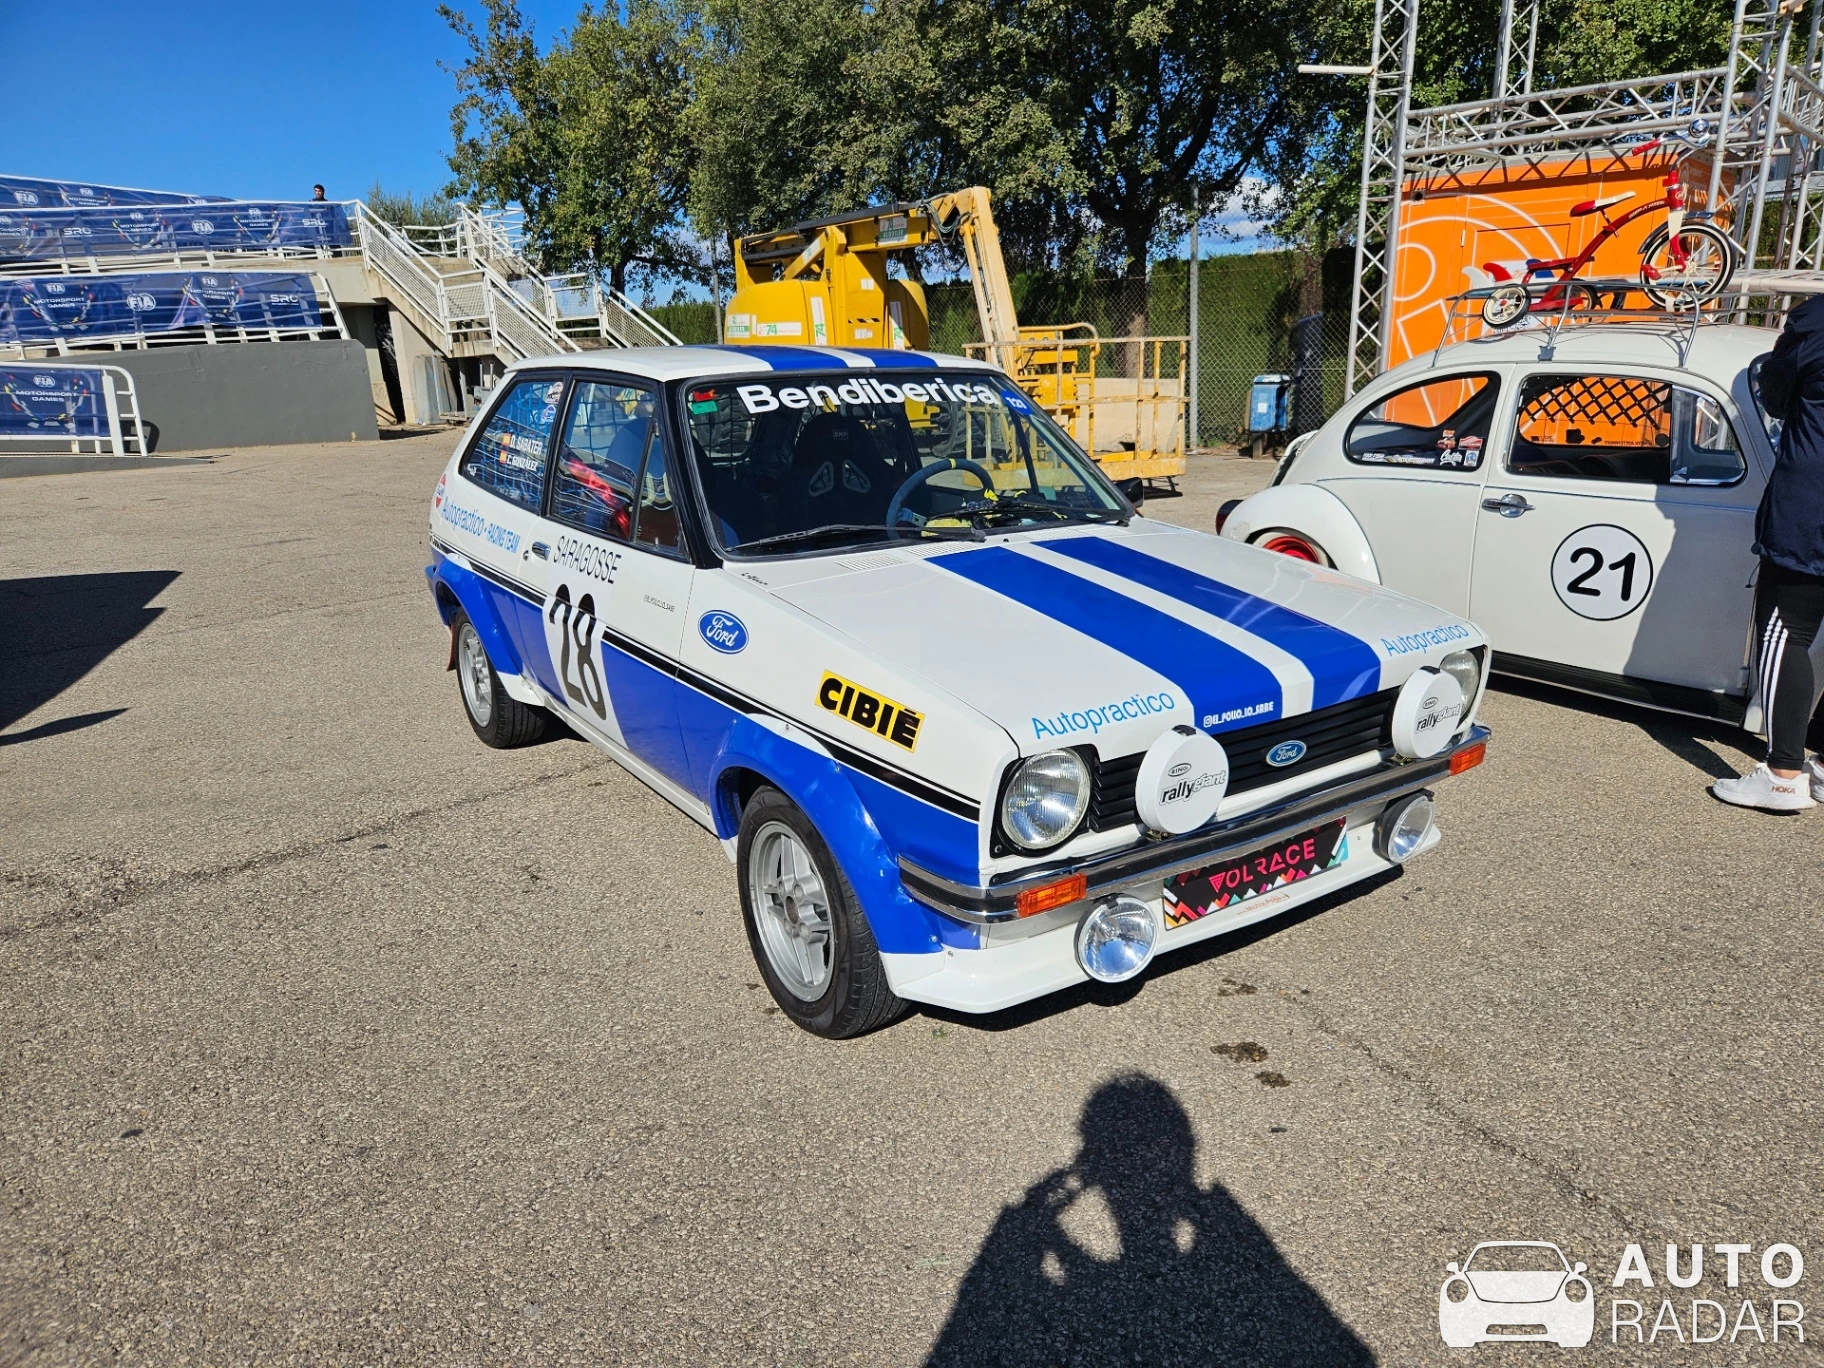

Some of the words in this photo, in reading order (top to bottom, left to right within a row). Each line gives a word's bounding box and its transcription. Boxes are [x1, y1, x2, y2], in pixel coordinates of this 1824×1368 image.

[193, 220, 214, 234] FIA
[46, 282, 66, 294] FIA
[128, 293, 156, 311] FIA
[33, 375, 55, 388] FIA
[736, 378, 999, 414] Bendiberica
[553, 535, 622, 585] SARAGOSSE
[1566, 547, 1636, 602] 21
[706, 615, 739, 647] Ford
[1380, 624, 1469, 656] Autopractico
[549, 583, 607, 721] 28
[1031, 692, 1175, 740] Autopractico
[1275, 745, 1298, 761] Ford
[1171, 765, 1189, 775] RING
[1771, 785, 1797, 794] HOKA
